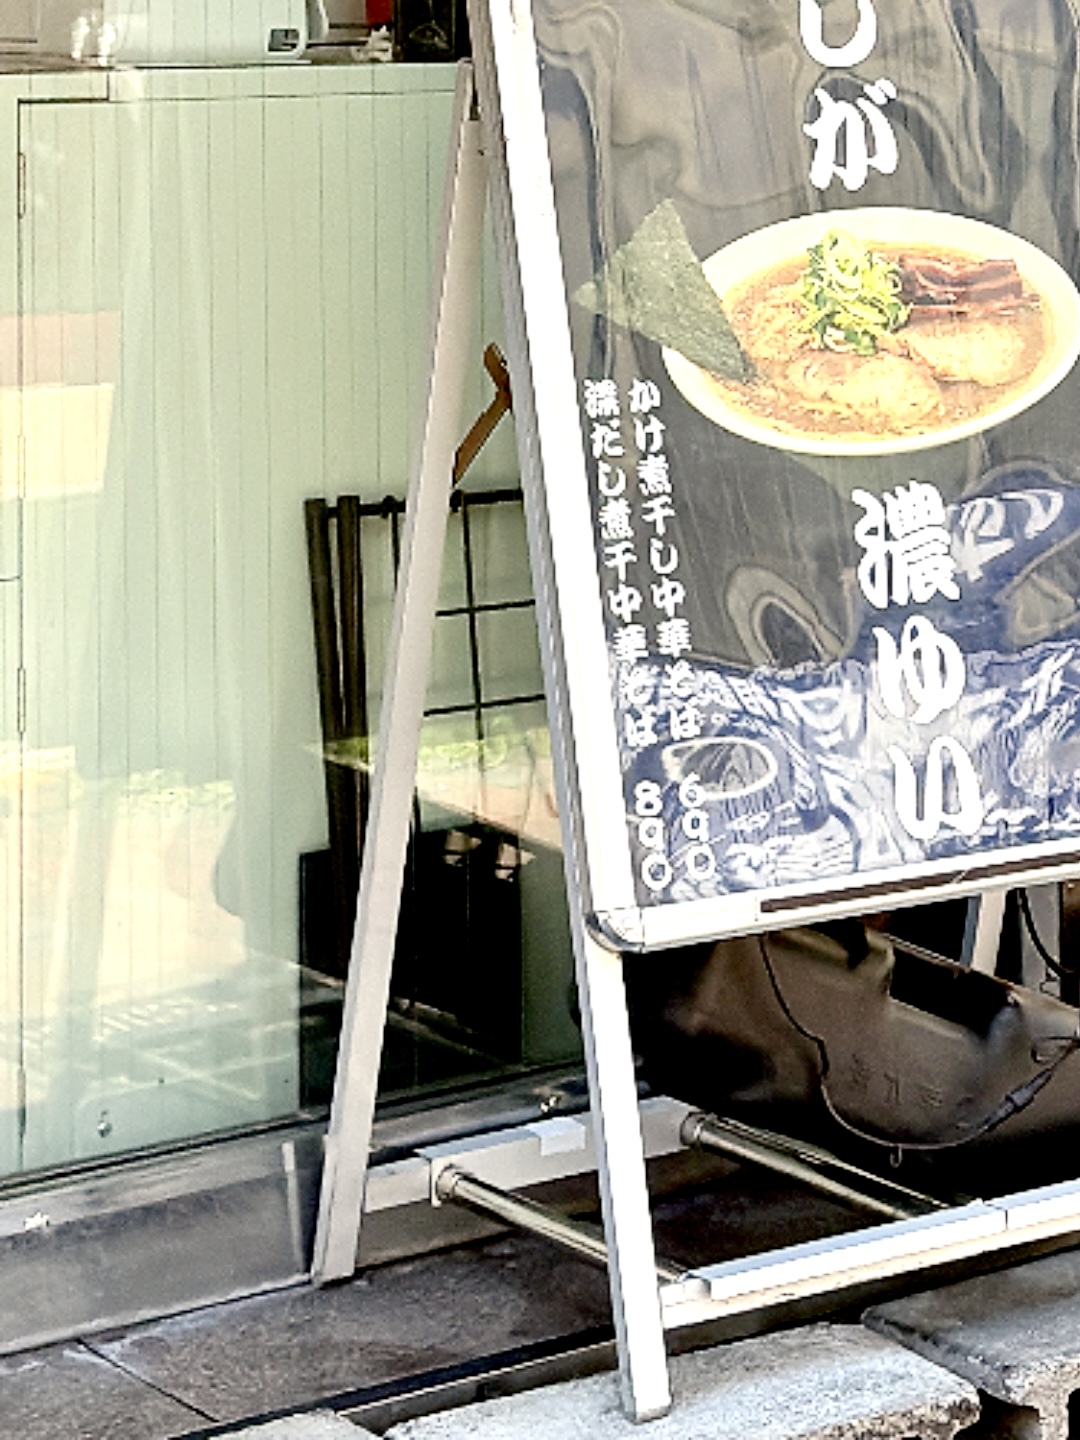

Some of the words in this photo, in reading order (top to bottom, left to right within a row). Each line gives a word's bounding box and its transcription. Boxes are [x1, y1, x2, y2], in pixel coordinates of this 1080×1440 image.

[852, 480, 985, 843] 濃ゆい
[634, 780, 674, 891] 890
[679, 773, 716, 882] 690
